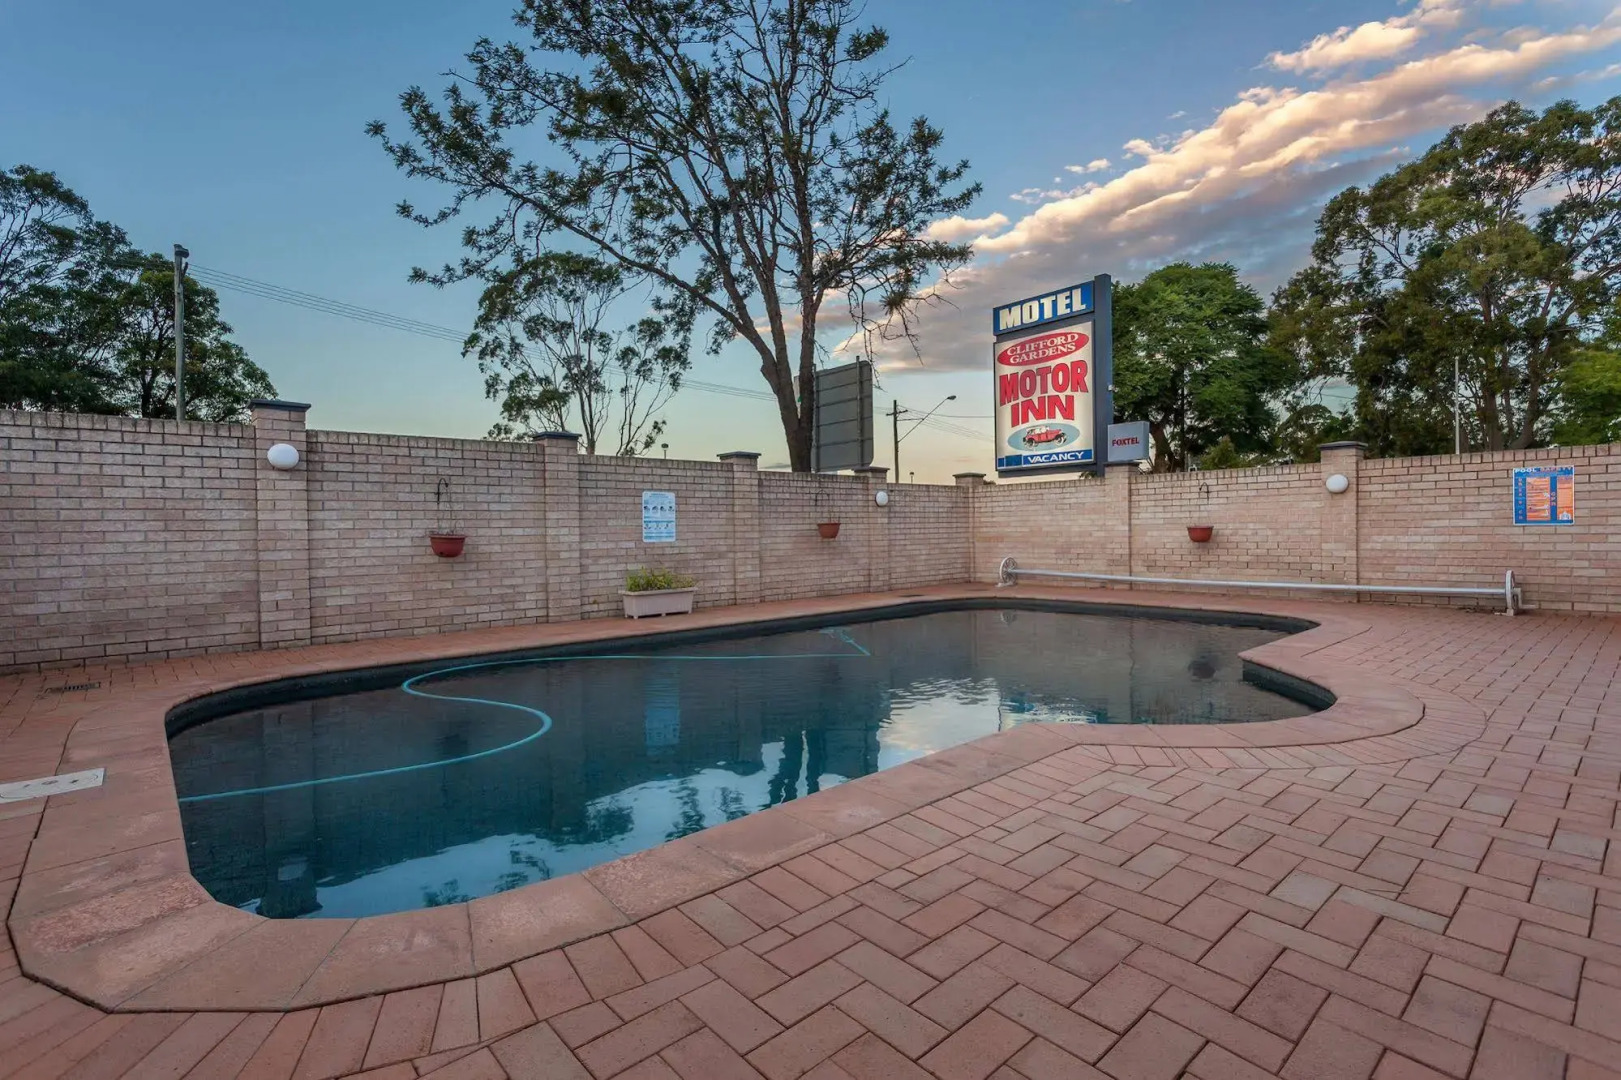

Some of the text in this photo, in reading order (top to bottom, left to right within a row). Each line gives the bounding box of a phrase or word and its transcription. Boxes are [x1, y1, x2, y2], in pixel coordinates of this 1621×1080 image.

[1000, 288, 1086, 330] MOTEL
[1007, 333, 1079, 356] CLIFFORD
[1010, 342, 1076, 364] GARDENS
[999, 360, 1088, 406] MOTOR
[1011, 395, 1075, 428] INN
[1112, 437, 1140, 447] FOXTEL
[1027, 451, 1084, 463] VACANCY
